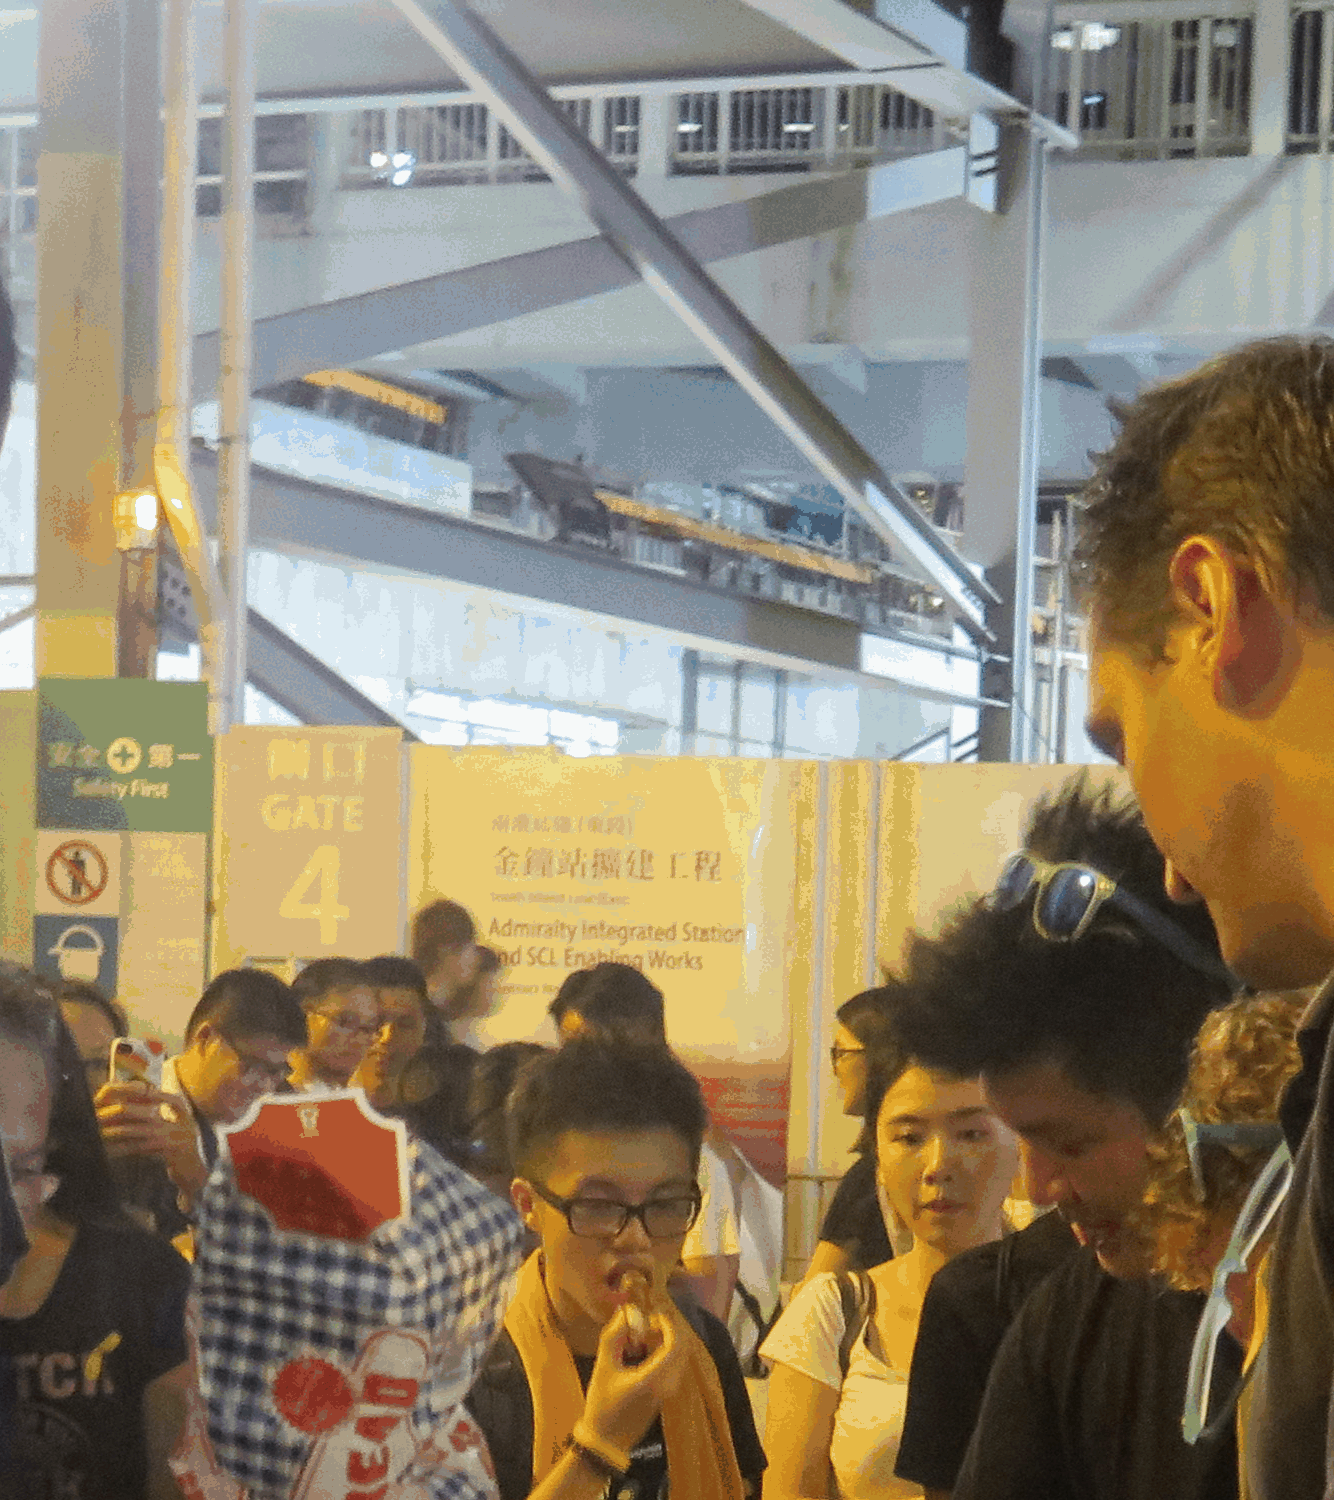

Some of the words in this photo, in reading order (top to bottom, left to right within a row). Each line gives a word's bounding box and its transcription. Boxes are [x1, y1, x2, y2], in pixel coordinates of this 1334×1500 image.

[131, 771, 170, 798] First
[260, 794, 364, 831] GATE
[279, 845, 350, 945] 4
[489, 917, 578, 944] Admiralty
[581, 919, 677, 945] Integrated
[682, 921, 745, 943] Station
[526, 946, 557, 967] SCL
[564, 947, 643, 972] Enabling
[647, 949, 703, 972] Works
